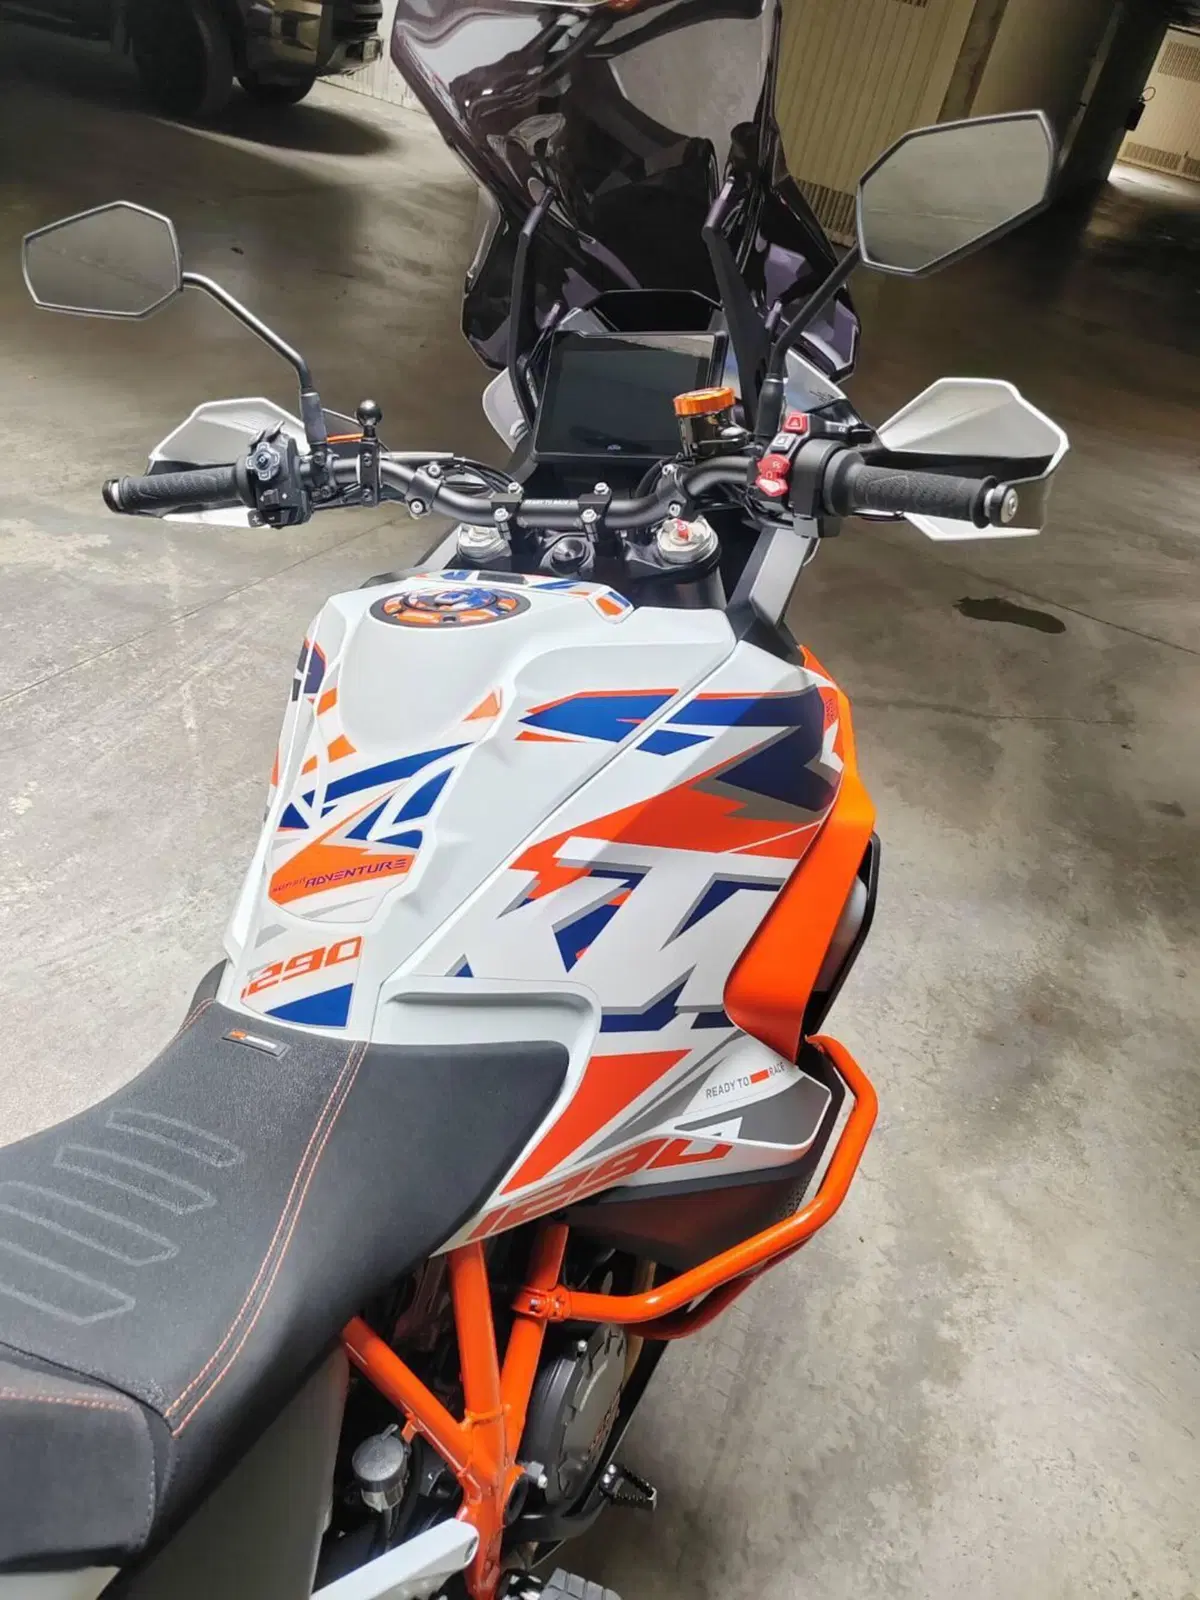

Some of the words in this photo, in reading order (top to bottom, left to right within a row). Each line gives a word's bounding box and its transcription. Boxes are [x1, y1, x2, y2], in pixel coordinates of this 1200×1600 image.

[304, 859, 407, 888] ADVENTURE
[705, 1080, 736, 1099] READY
[736, 1075, 750, 1089] TO
